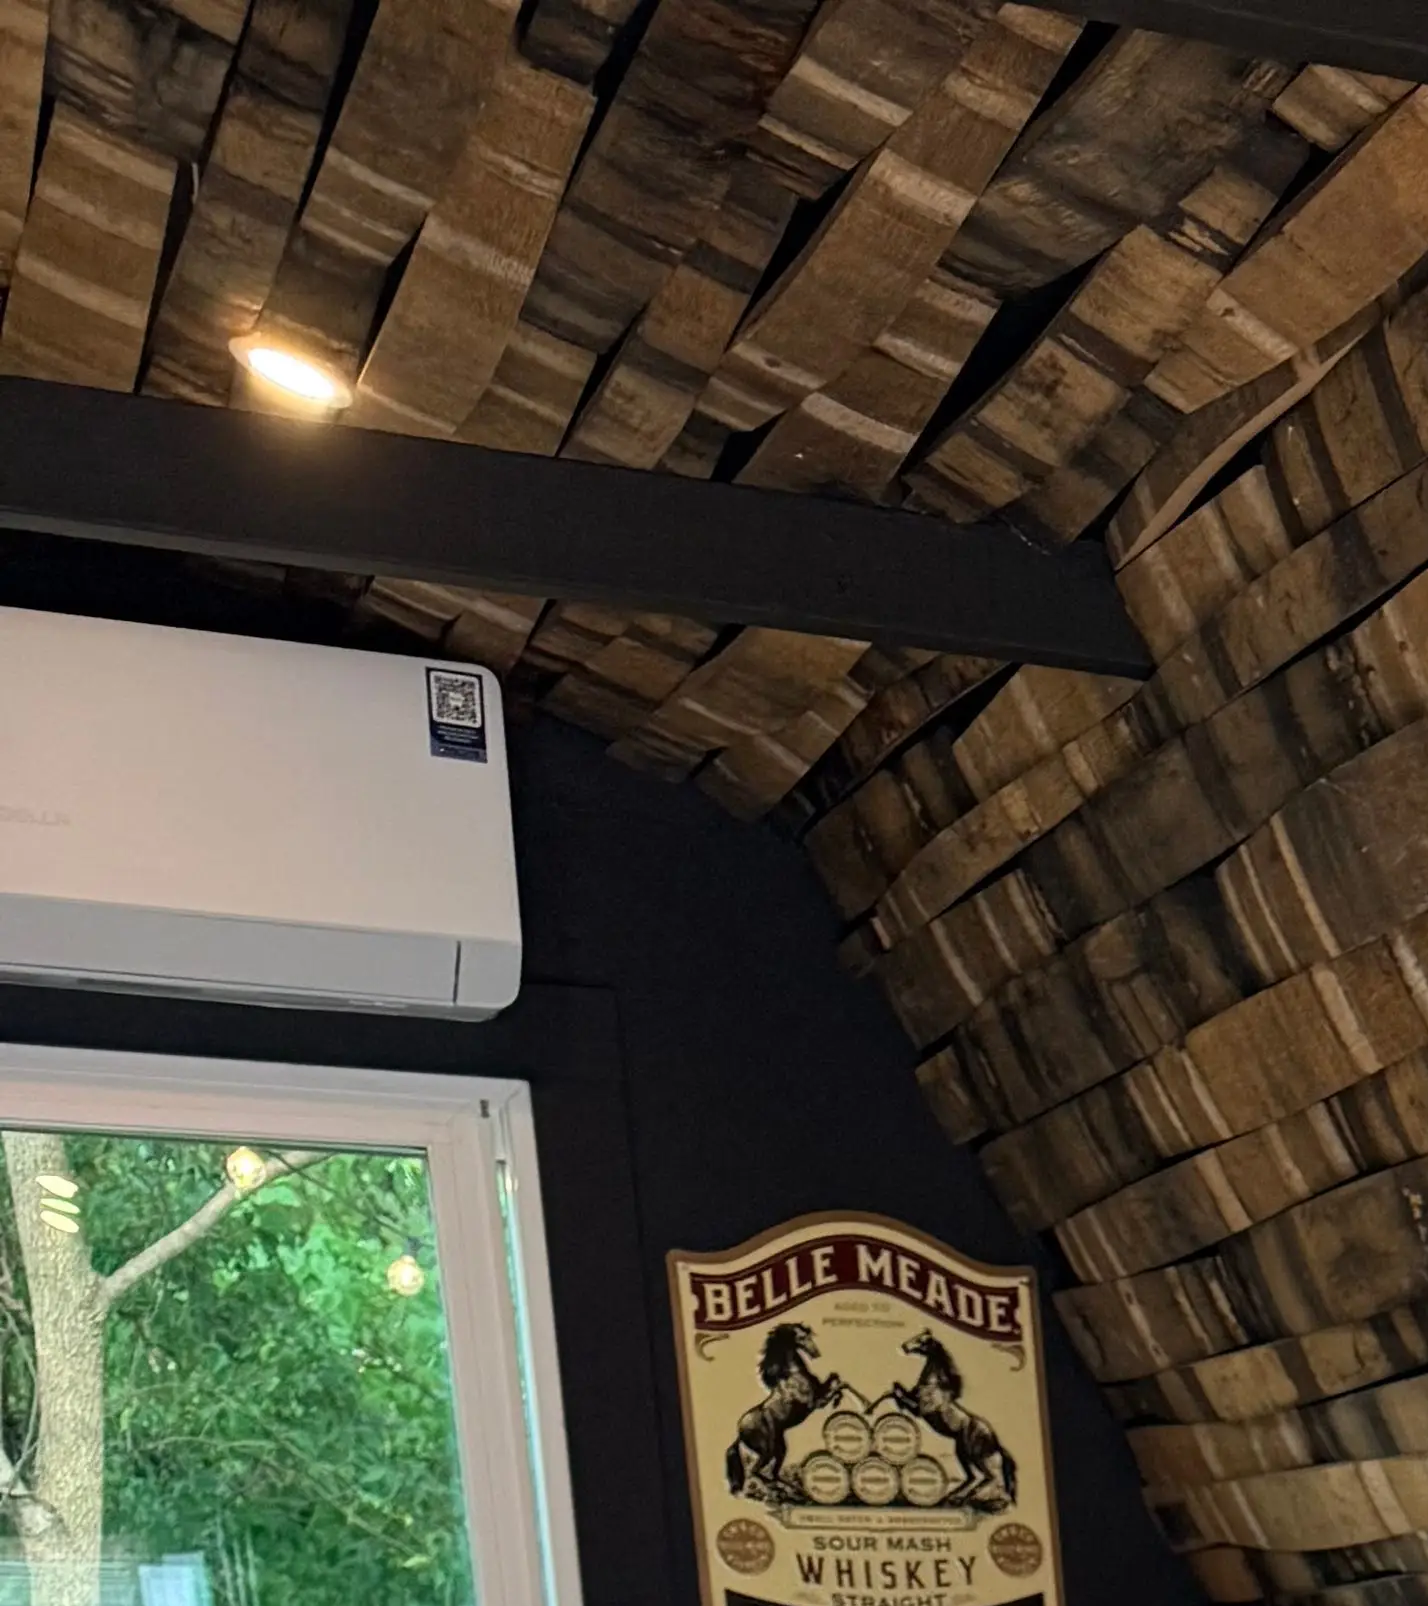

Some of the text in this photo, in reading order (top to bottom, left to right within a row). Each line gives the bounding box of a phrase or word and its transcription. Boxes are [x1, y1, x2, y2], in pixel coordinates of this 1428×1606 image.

[703, 1245, 1013, 1335] BELLE MEADE
[813, 1536, 952, 1553] SOUR MASH
[796, 1554, 978, 1590] WHISKEY
